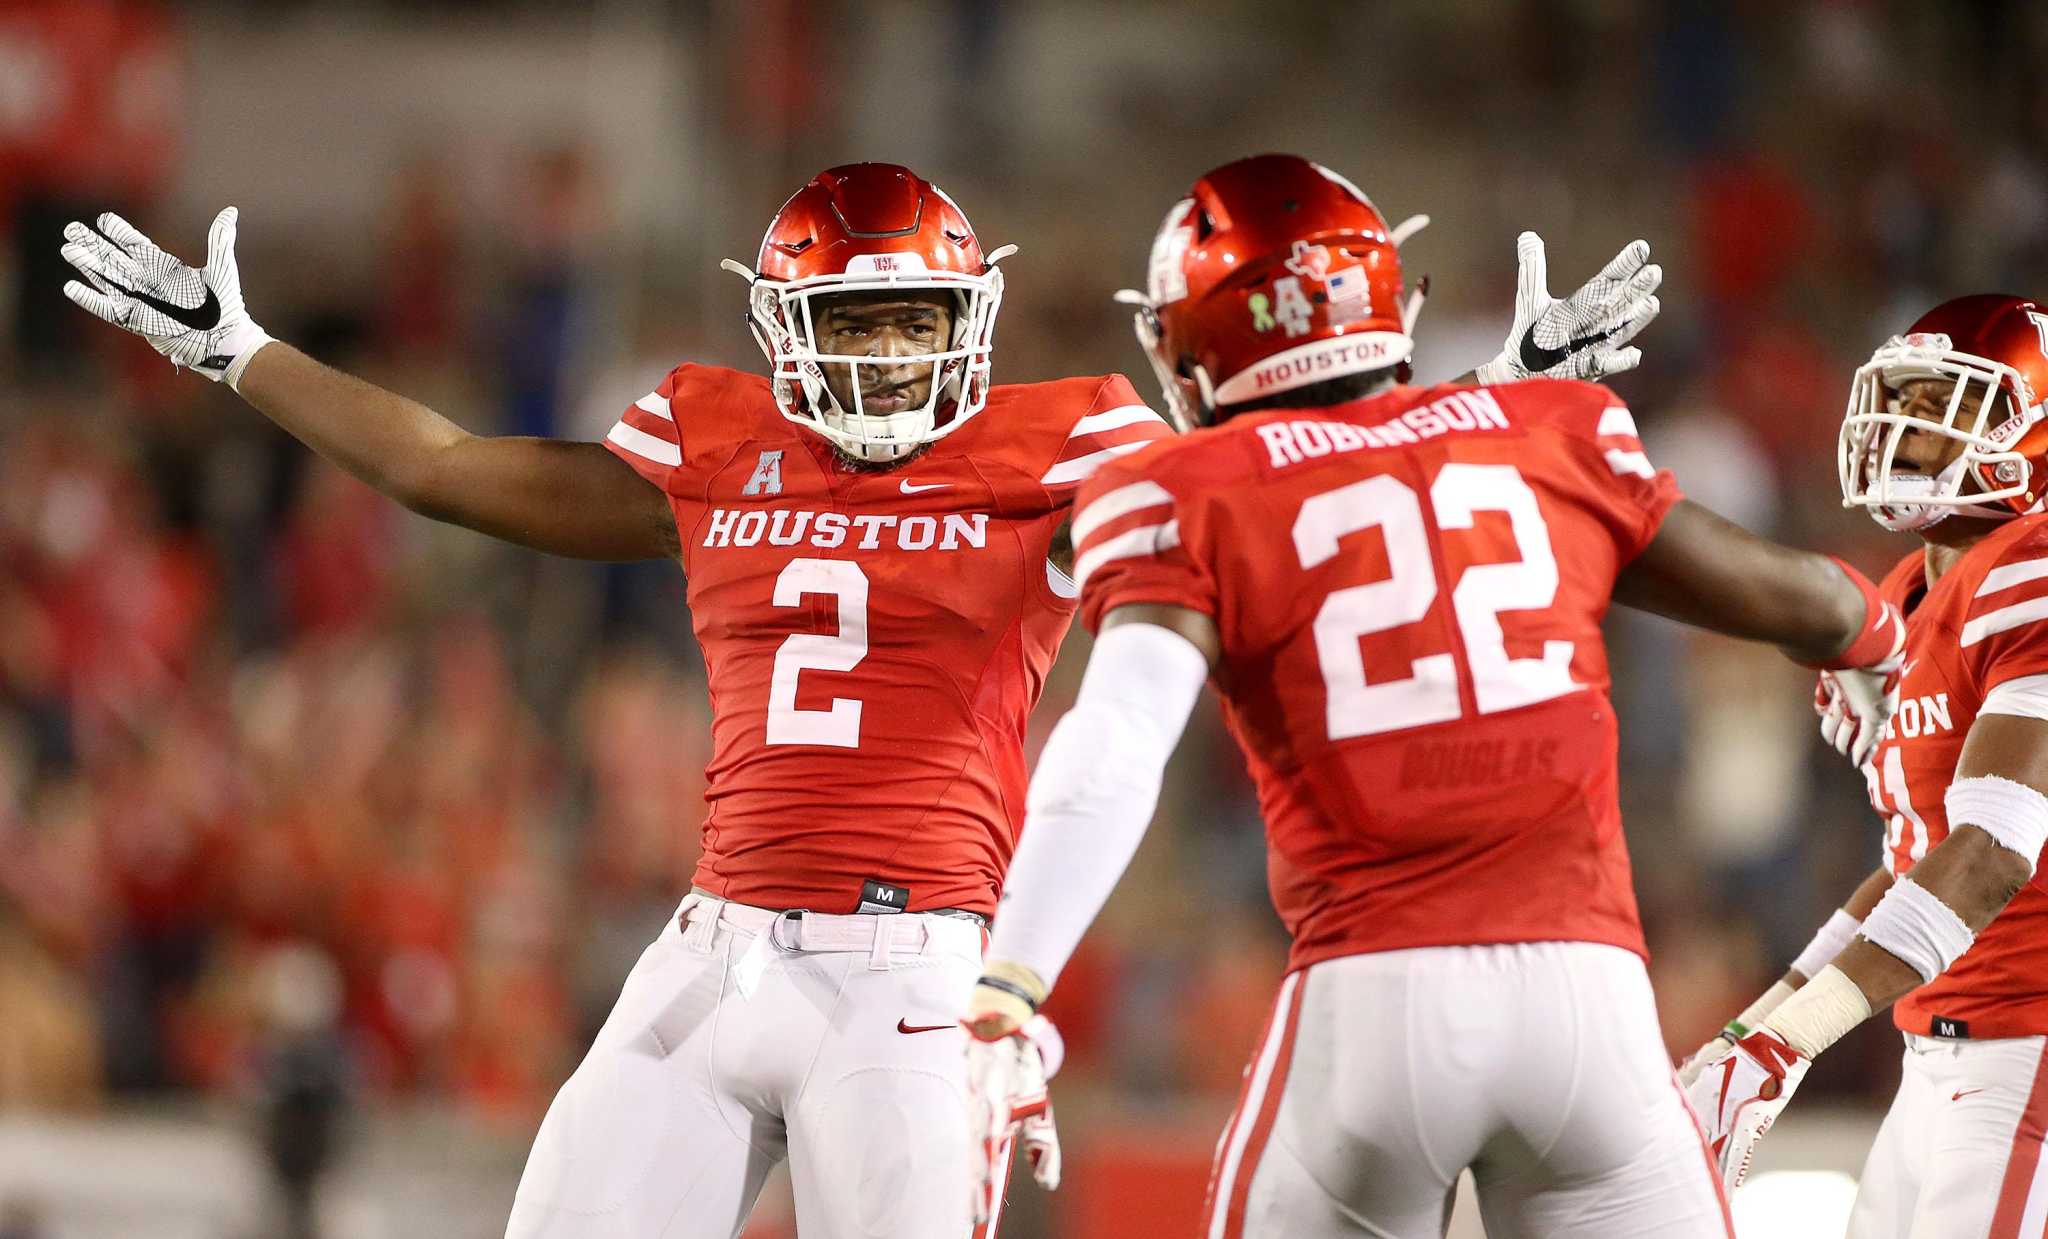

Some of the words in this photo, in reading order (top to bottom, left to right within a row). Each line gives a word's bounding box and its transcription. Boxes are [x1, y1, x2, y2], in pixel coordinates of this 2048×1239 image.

[1255, 342, 1386, 388] HOUSTON
[1256, 388, 1510, 469] ROBINSON
[702, 510, 989, 550] HOUSTON
[1291, 463, 1591, 741] 22
[765, 557, 869, 749] 2
[876, 888, 894, 902] M
[1941, 1021, 1956, 1037] M
